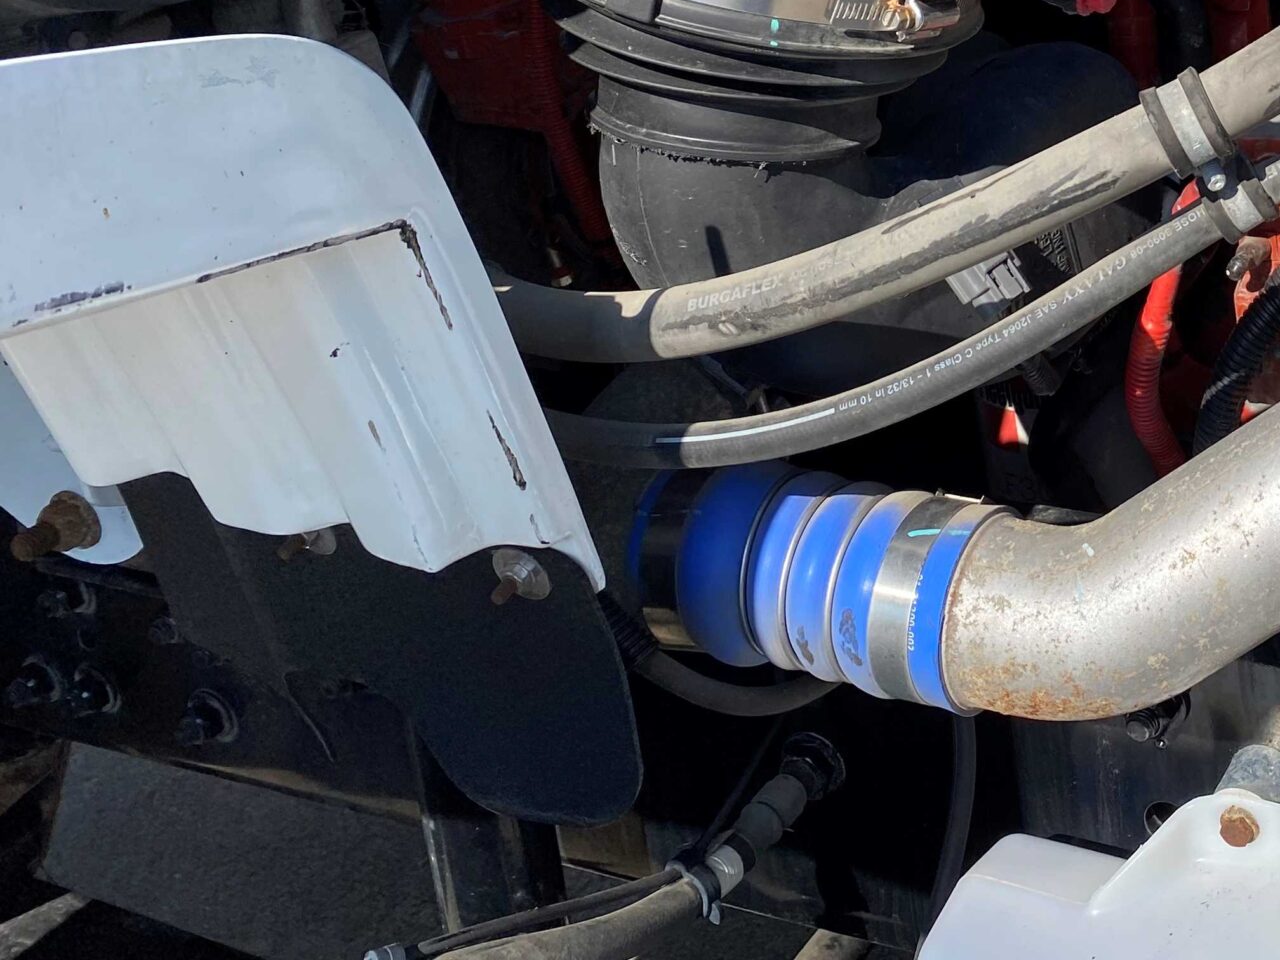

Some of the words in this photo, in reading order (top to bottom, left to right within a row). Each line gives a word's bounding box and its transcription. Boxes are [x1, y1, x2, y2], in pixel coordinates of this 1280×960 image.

[1062, 256, 1126, 304] GALAXY
[687, 274, 783, 312] BURGAFLEX
[1034, 300, 1058, 319] SAE
[1002, 315, 1032, 338] J2064
[975, 333, 1002, 350] Type
[964, 348, 973, 358] C
[934, 354, 963, 372] Class
[925, 368, 932, 378] 1
[875, 388, 885, 398] in
[887, 376, 914, 395] 13/32
[839, 400, 857, 411] mm
[860, 393, 872, 405] 10
